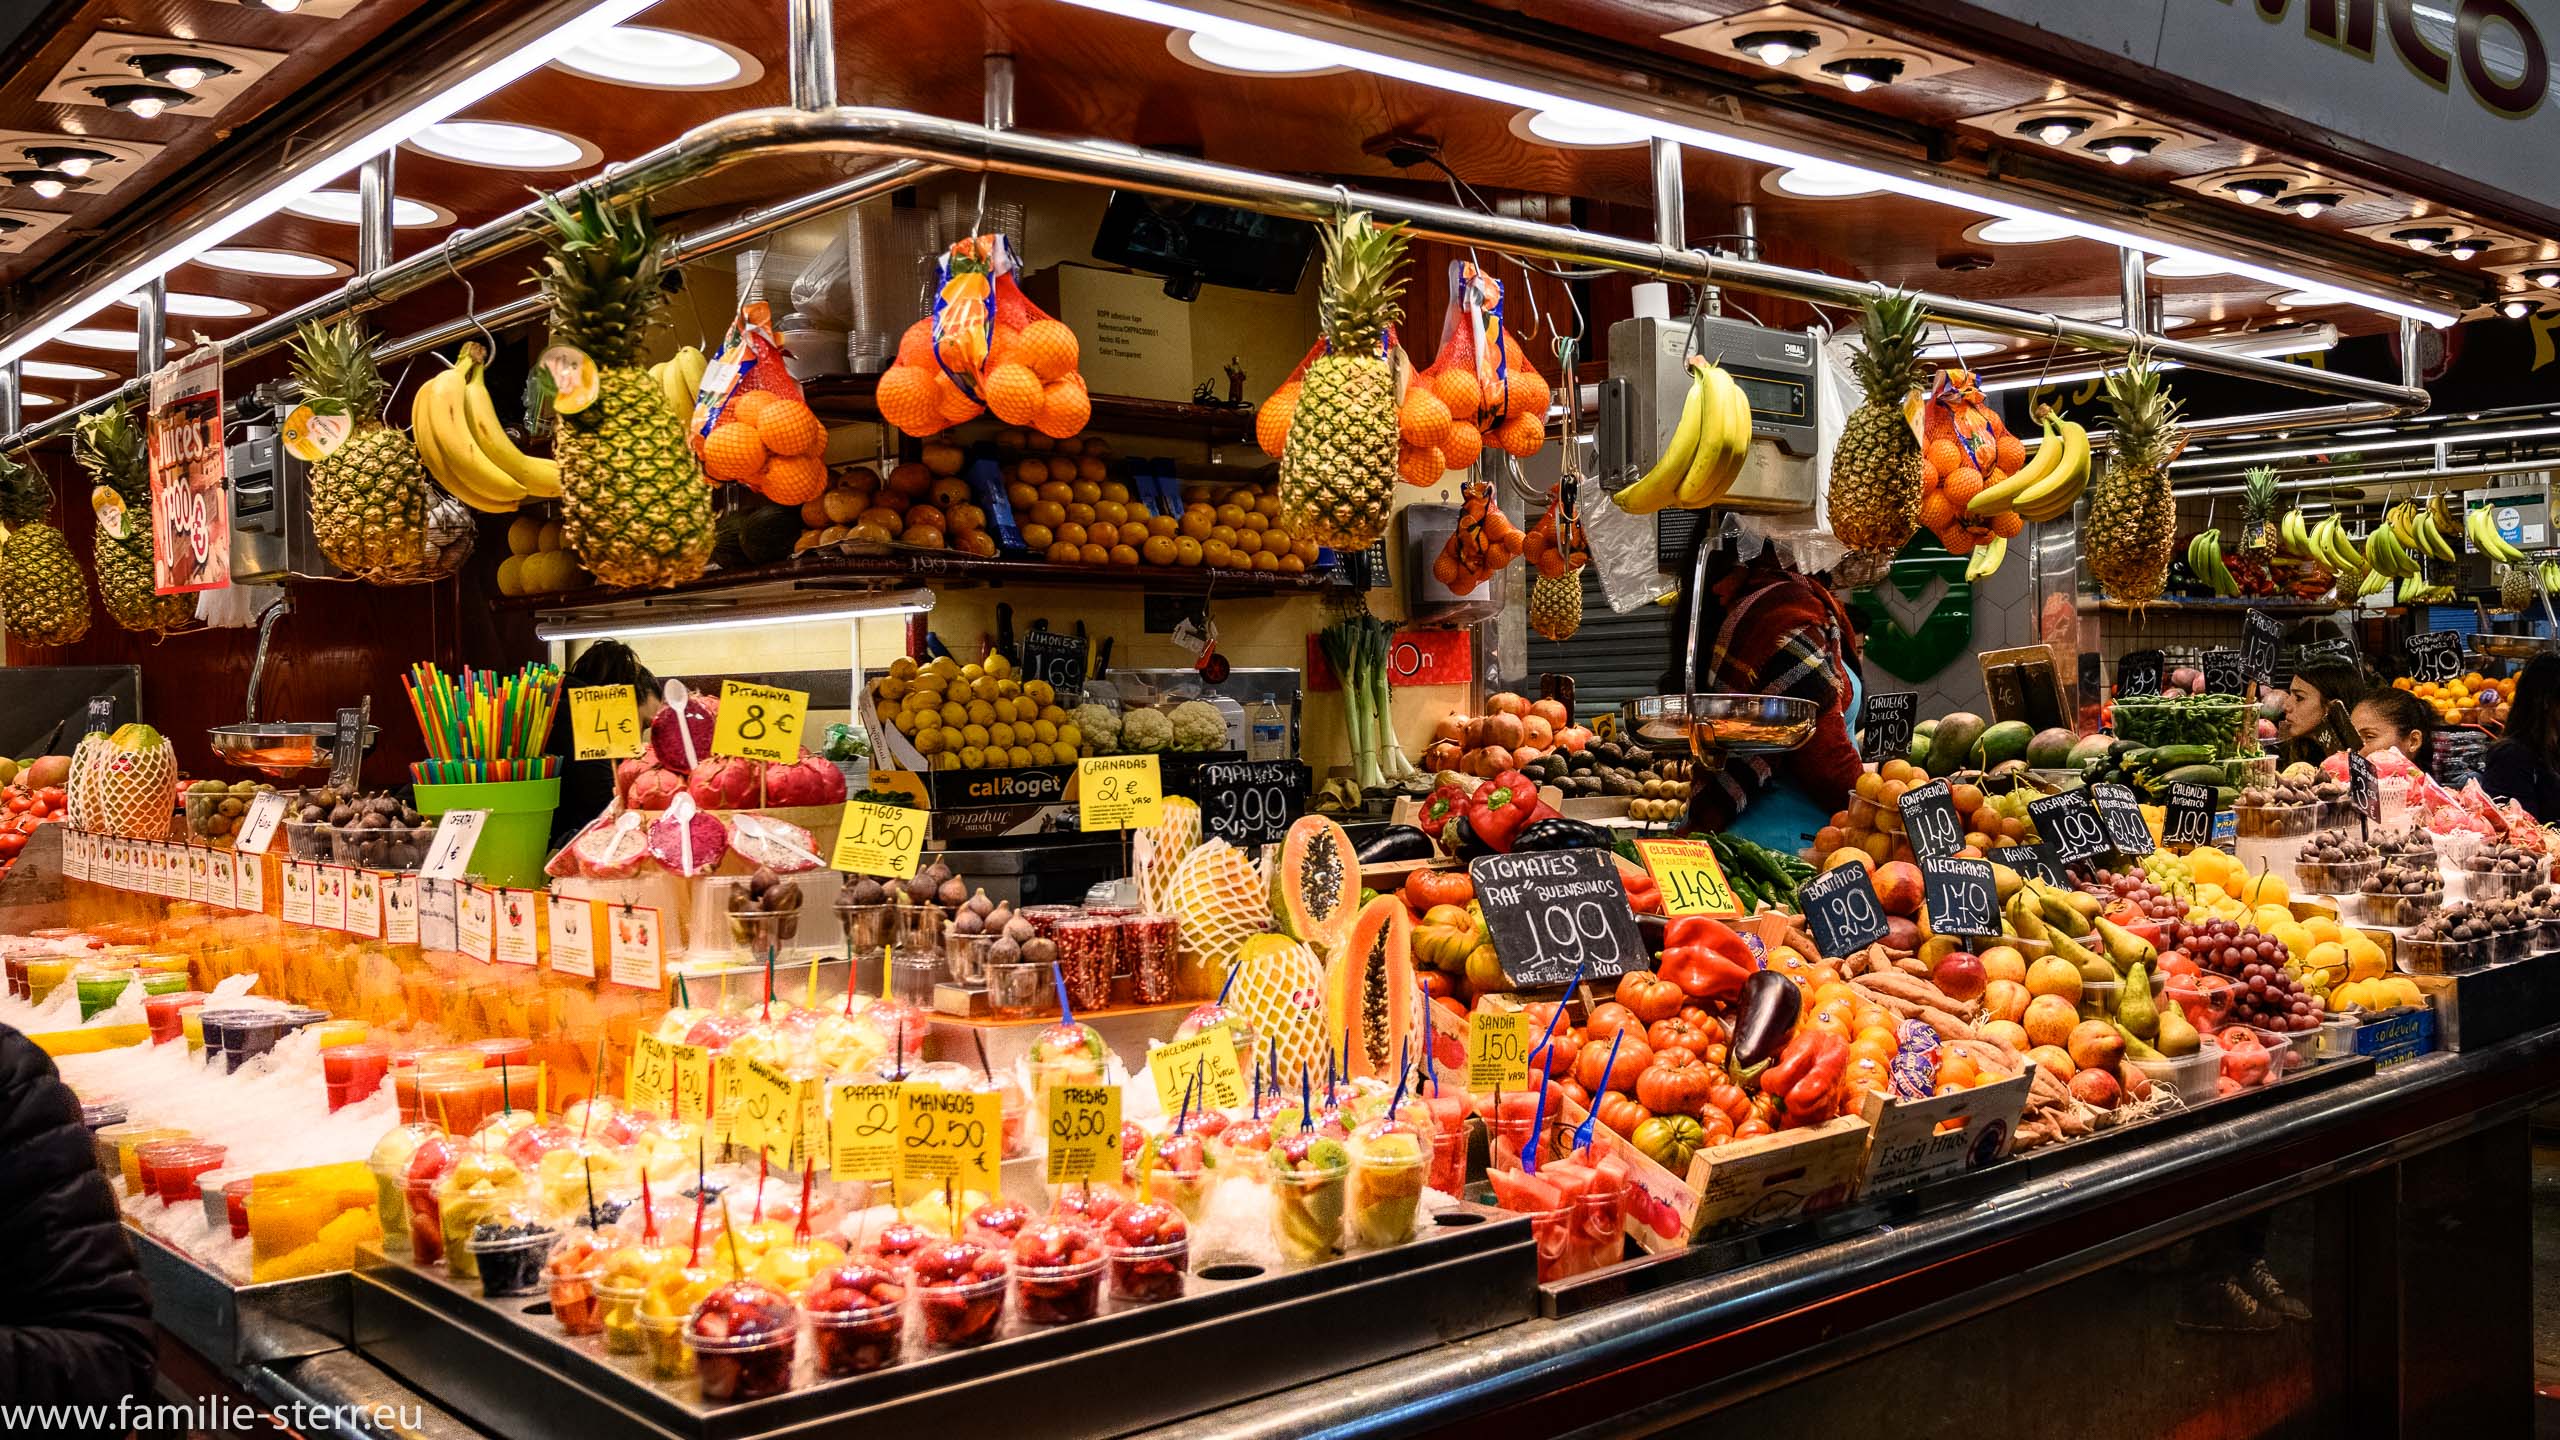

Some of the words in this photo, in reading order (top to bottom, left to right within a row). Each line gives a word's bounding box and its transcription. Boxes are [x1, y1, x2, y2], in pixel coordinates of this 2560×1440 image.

[1784, 344, 1805, 355] DIBAL
[158, 419, 202, 468] Juices
[1870, 695, 1909, 710] CIRUELAS
[594, 709, 611, 744] 4
[738, 705, 766, 740] 8
[1084, 759, 1147, 776] GRANADAS
[969, 773, 1061, 798] calRoget
[1098, 776, 1119, 801] 2
[1901, 783, 1949, 807] CONFERENCIA
[2172, 783, 2208, 800] CALANDA
[859, 804, 902, 820] HIGOS
[1211, 787, 1286, 838] 2,99
[2030, 792, 2083, 814] ROSADAS
[845, 817, 912, 851] 1.50
[1916, 807, 1957, 857] 1,49
[2057, 813, 2102, 857] 1,99
[2002, 847, 2038, 862] KAKIS
[1535, 880, 1618, 902] BUENISIMOS
[1520, 901, 1620, 968] 1,99
[1593, 961, 1622, 977] KILO
[1156, 1036, 1212, 1060] MACEDONIAS
[1478, 1033, 1518, 1064] 1,50
[909, 1093, 974, 1114] MANGOS
[1063, 1088, 1108, 1105] FRESAS
[905, 1112, 985, 1148] 2.50
[1880, 1138, 1926, 1167] Escrig
[1929, 1132, 1968, 1154] Hnos.
